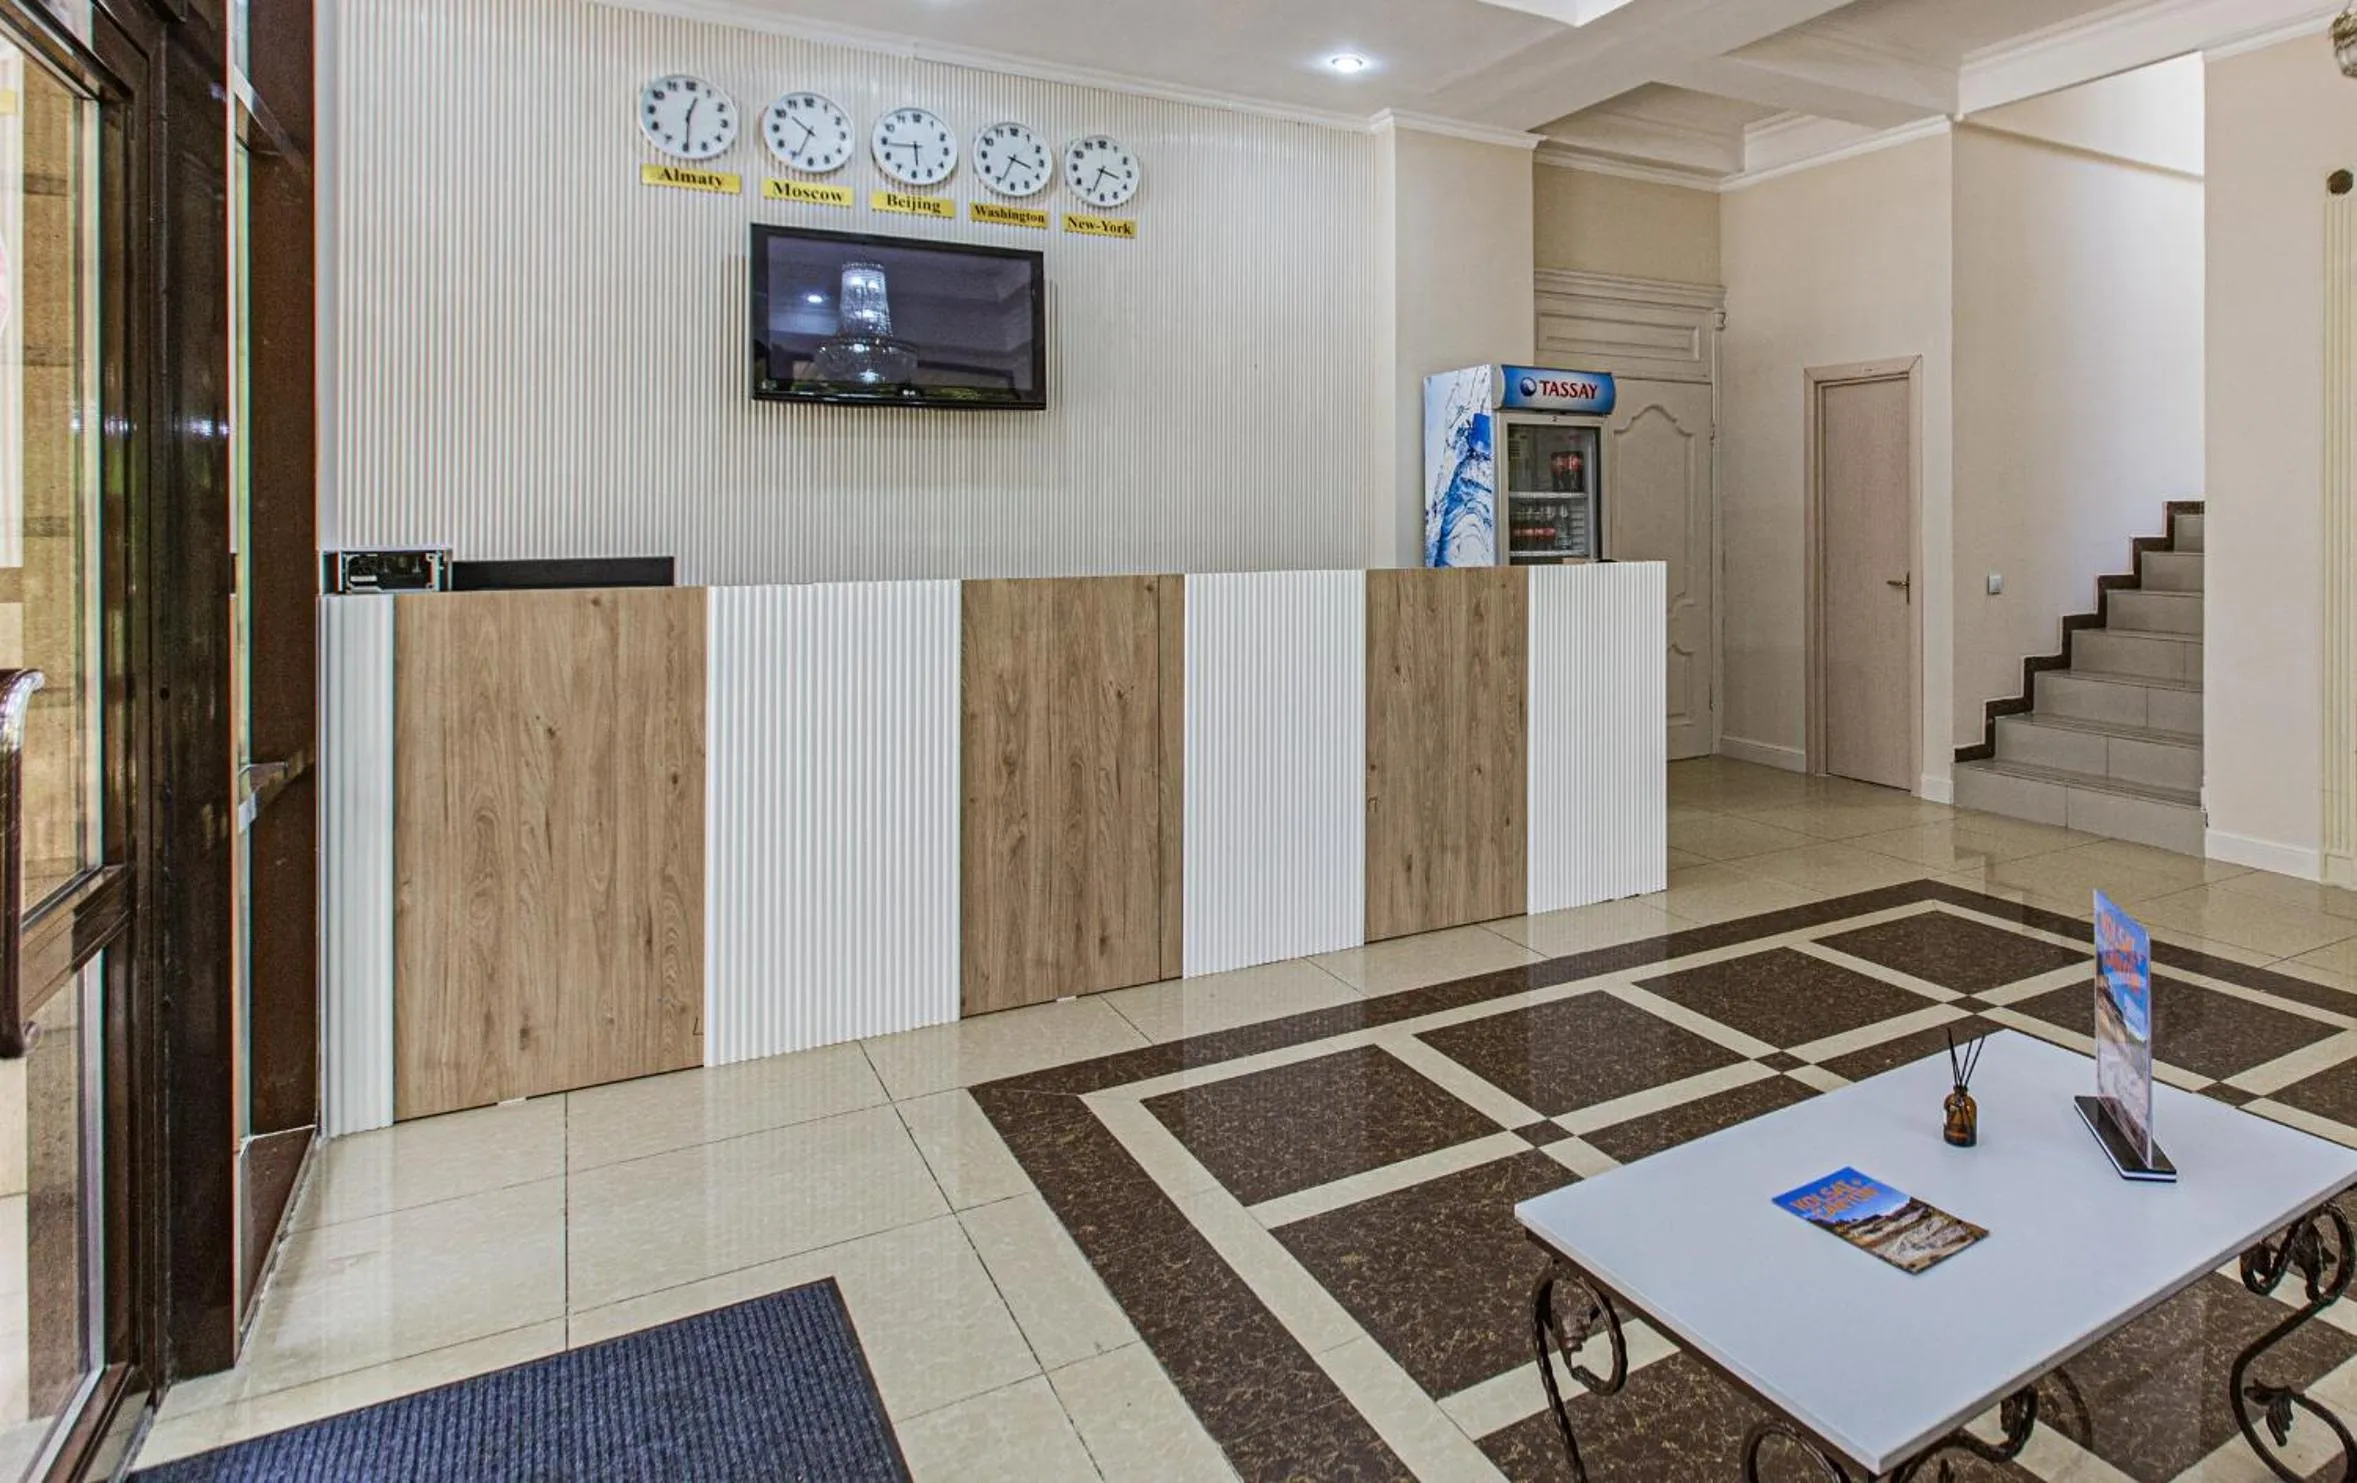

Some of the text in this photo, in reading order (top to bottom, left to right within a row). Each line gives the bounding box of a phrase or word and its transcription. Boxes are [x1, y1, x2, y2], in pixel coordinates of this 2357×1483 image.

[660, 167, 724, 189] Almaty
[772, 181, 843, 202] Moscow
[886, 193, 941, 213] Beijing
[974, 204, 1046, 223] Washington
[1067, 216, 1132, 236] New-York
[1540, 380, 1598, 399] TASSAY
